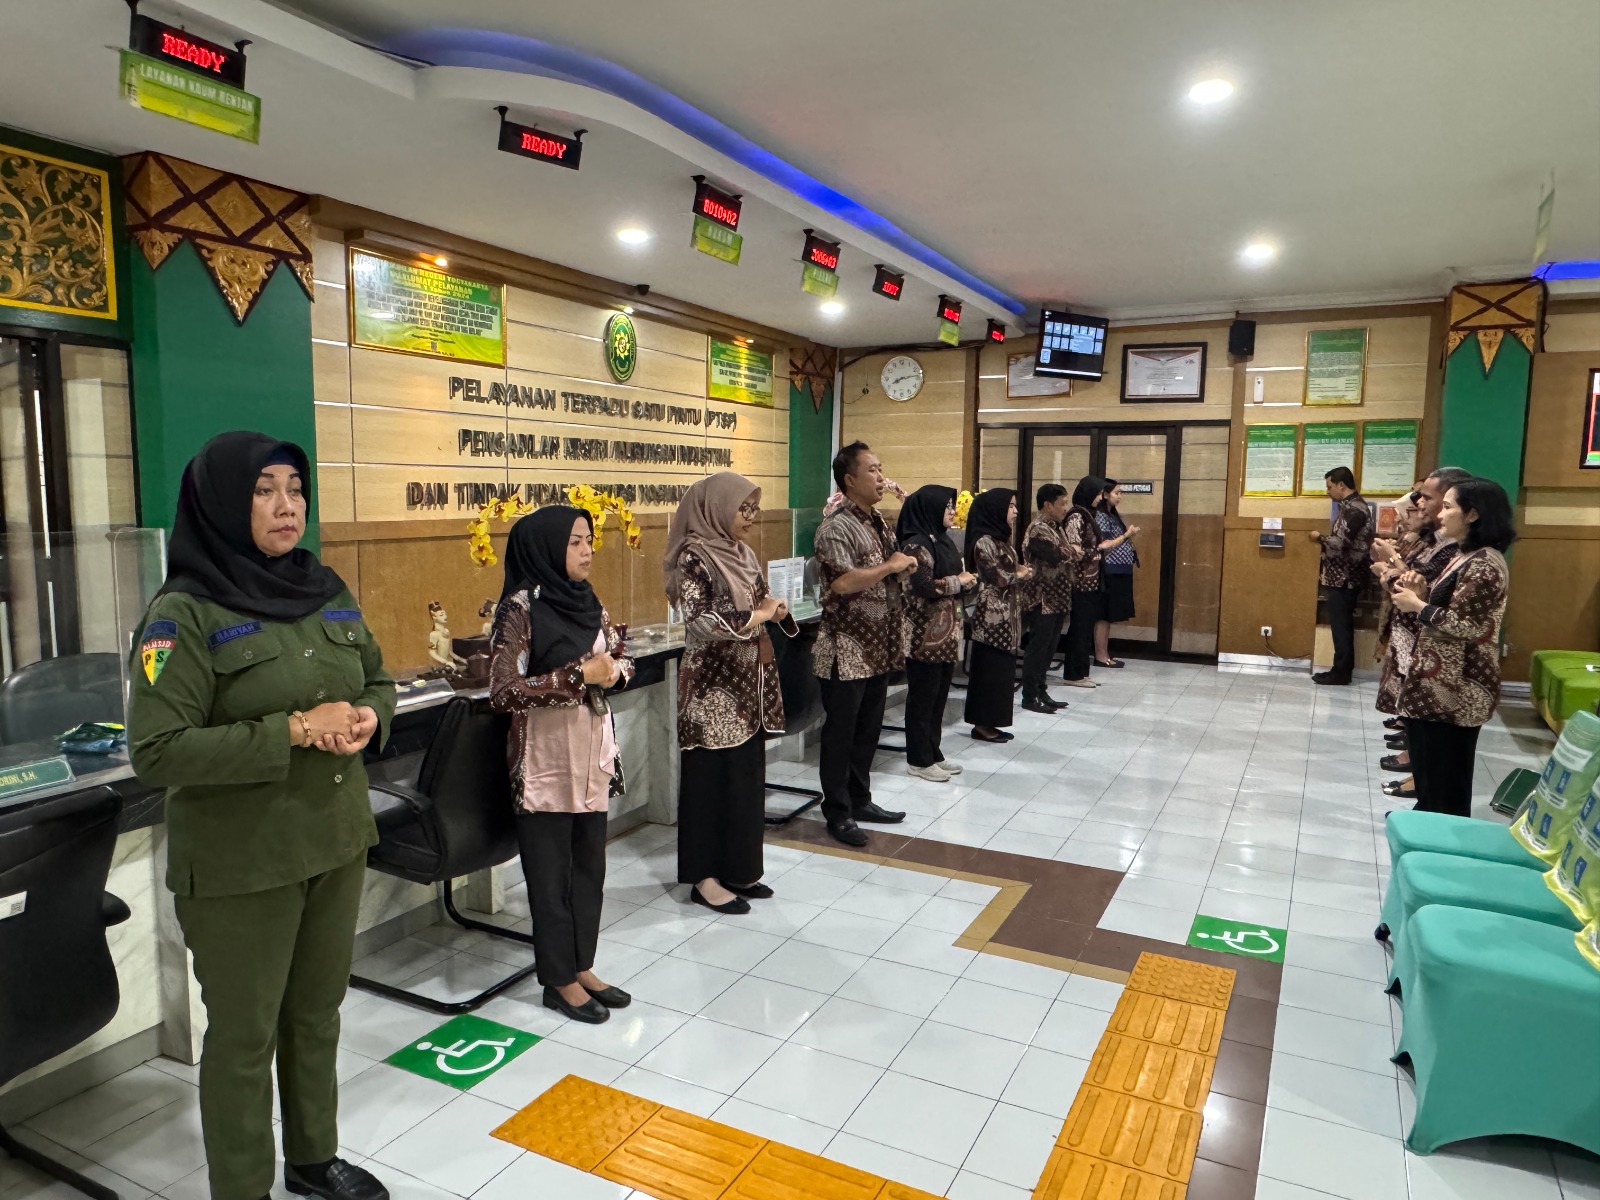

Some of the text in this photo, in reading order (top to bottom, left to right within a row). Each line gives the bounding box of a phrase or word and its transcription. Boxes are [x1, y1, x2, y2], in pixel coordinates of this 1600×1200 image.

[162, 33, 225, 73] READY
[521, 132, 567, 159] READY
[433, 279, 473, 296] PELAYANAN
[448, 376, 556, 411] PELAYANAN
[406, 481, 448, 511] DAN
